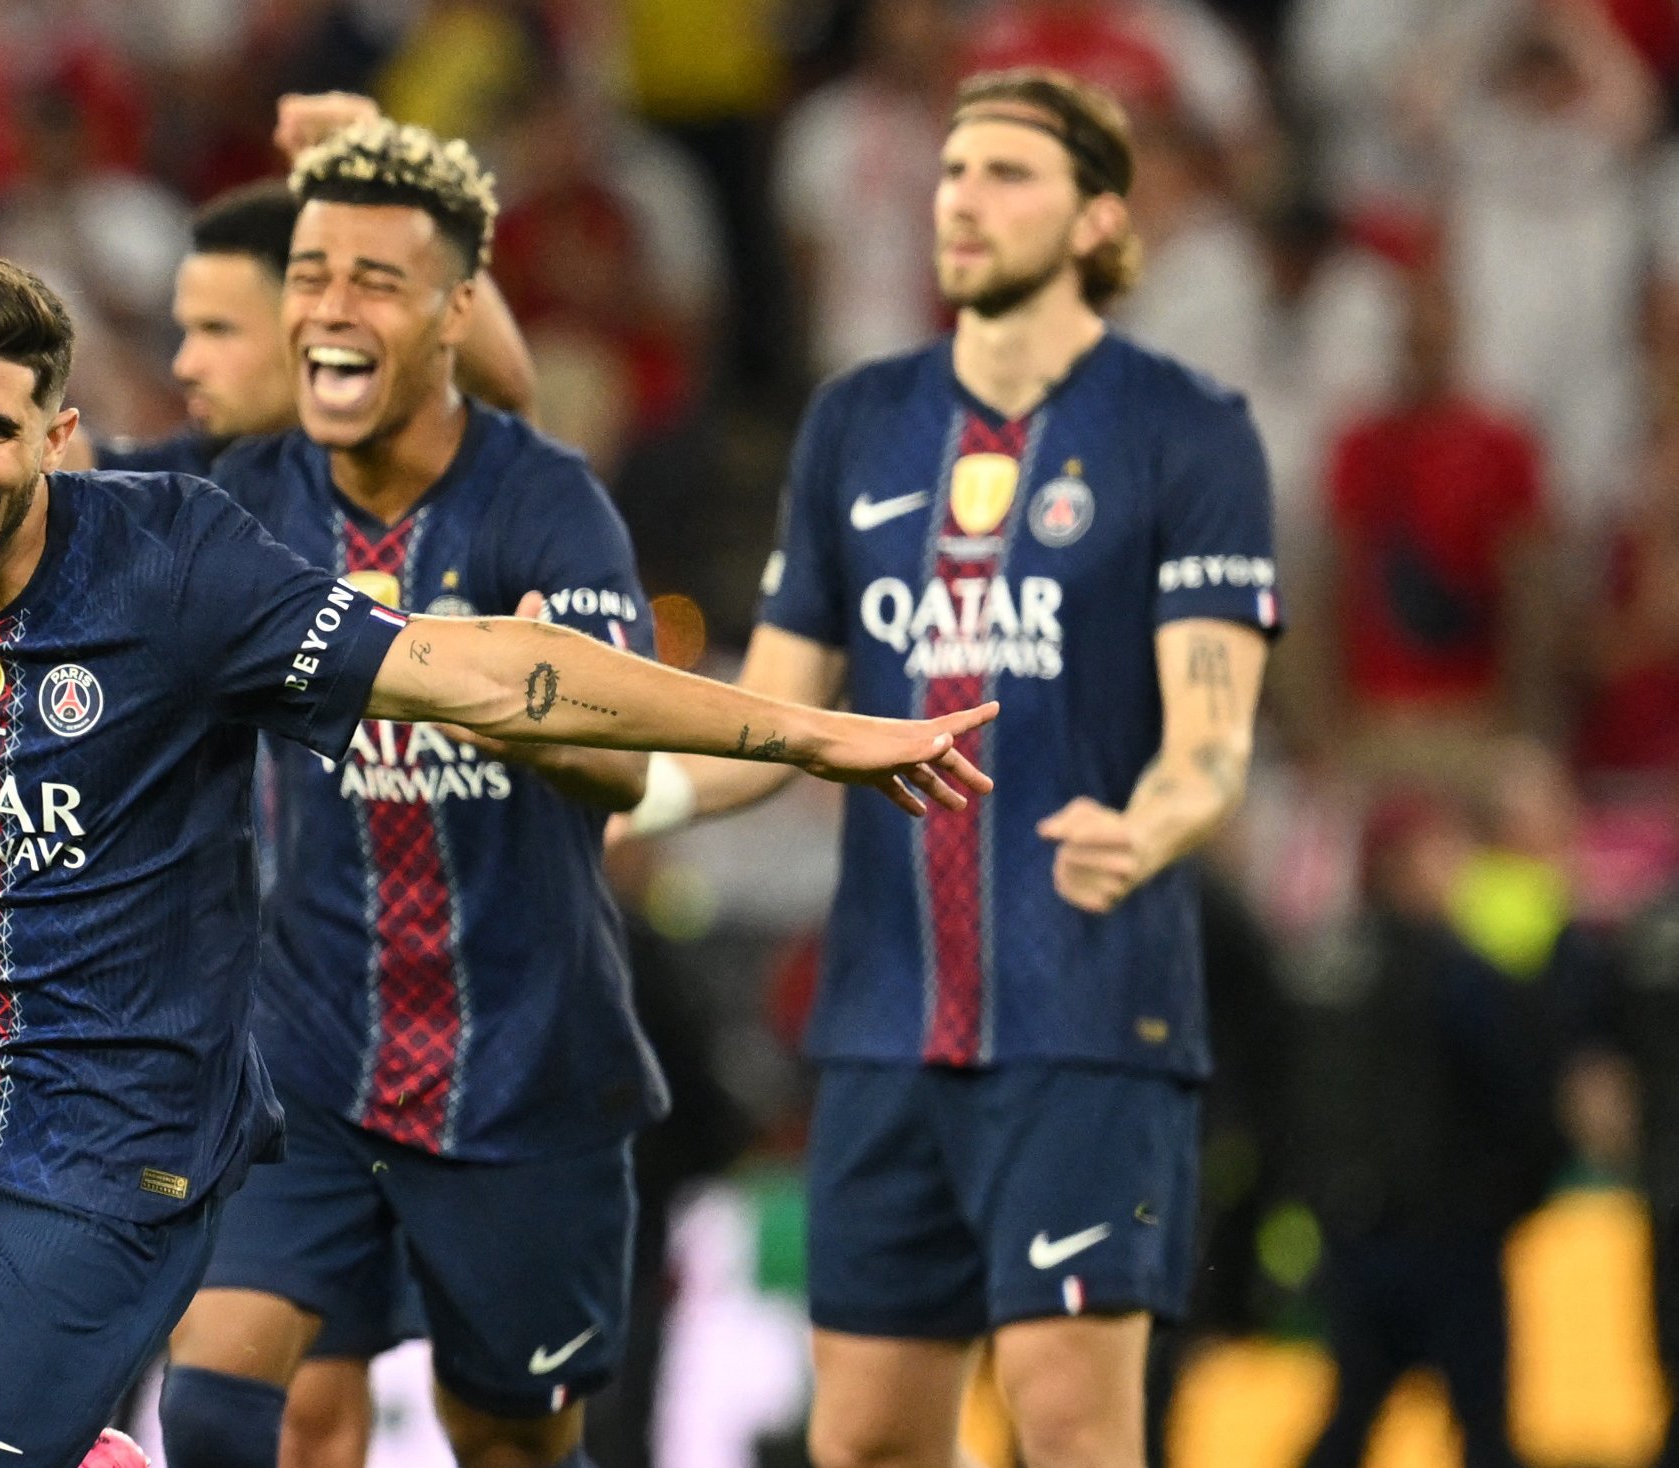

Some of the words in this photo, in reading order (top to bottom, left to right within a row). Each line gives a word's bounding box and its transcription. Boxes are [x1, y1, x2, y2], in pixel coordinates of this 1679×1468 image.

[1159, 555, 1274, 593] BEYON
[860, 576, 1062, 653] QATAR
[50, 667, 93, 687] PARIS
[340, 761, 512, 803] AIRWAYS
